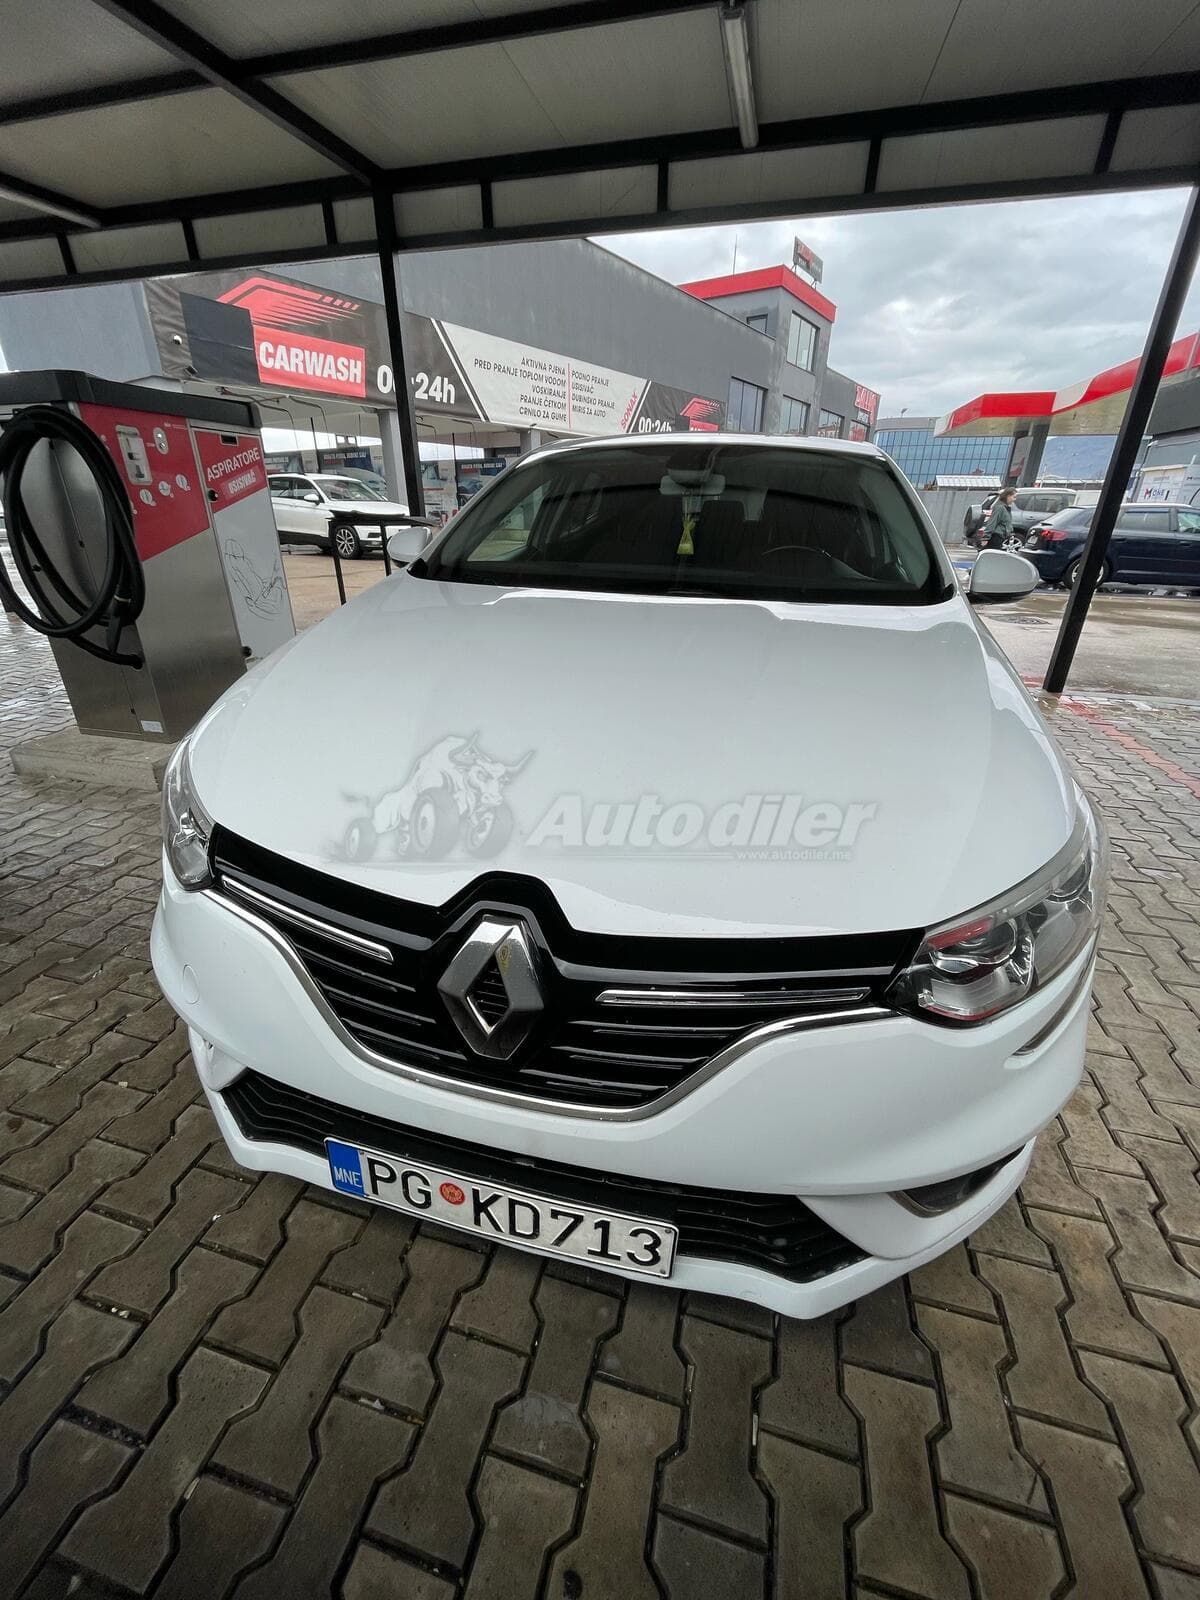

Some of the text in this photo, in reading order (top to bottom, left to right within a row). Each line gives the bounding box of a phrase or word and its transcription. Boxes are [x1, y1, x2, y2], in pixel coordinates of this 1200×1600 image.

[259, 341, 362, 384] CARWASH
[521, 357, 566, 376] AKTIVNA PJENA
[474, 358, 566, 387] PRED PRANJE TOPLOM VODOM
[572, 370, 609, 387] PODNO PRANJE
[532, 385, 566, 399] VOSKIRANJE
[520, 395, 566, 410] PRANJE ČETKOM
[597, 398, 615, 409] PRANJE
[620, 390, 638, 430] SONAX
[519, 406, 566, 422] CRNILO ZA GUME
[593, 408, 606, 418] AUTO
[207, 447, 261, 481] ASPIRATORE
[333, 1157, 663, 1267] MNE PG KD713
